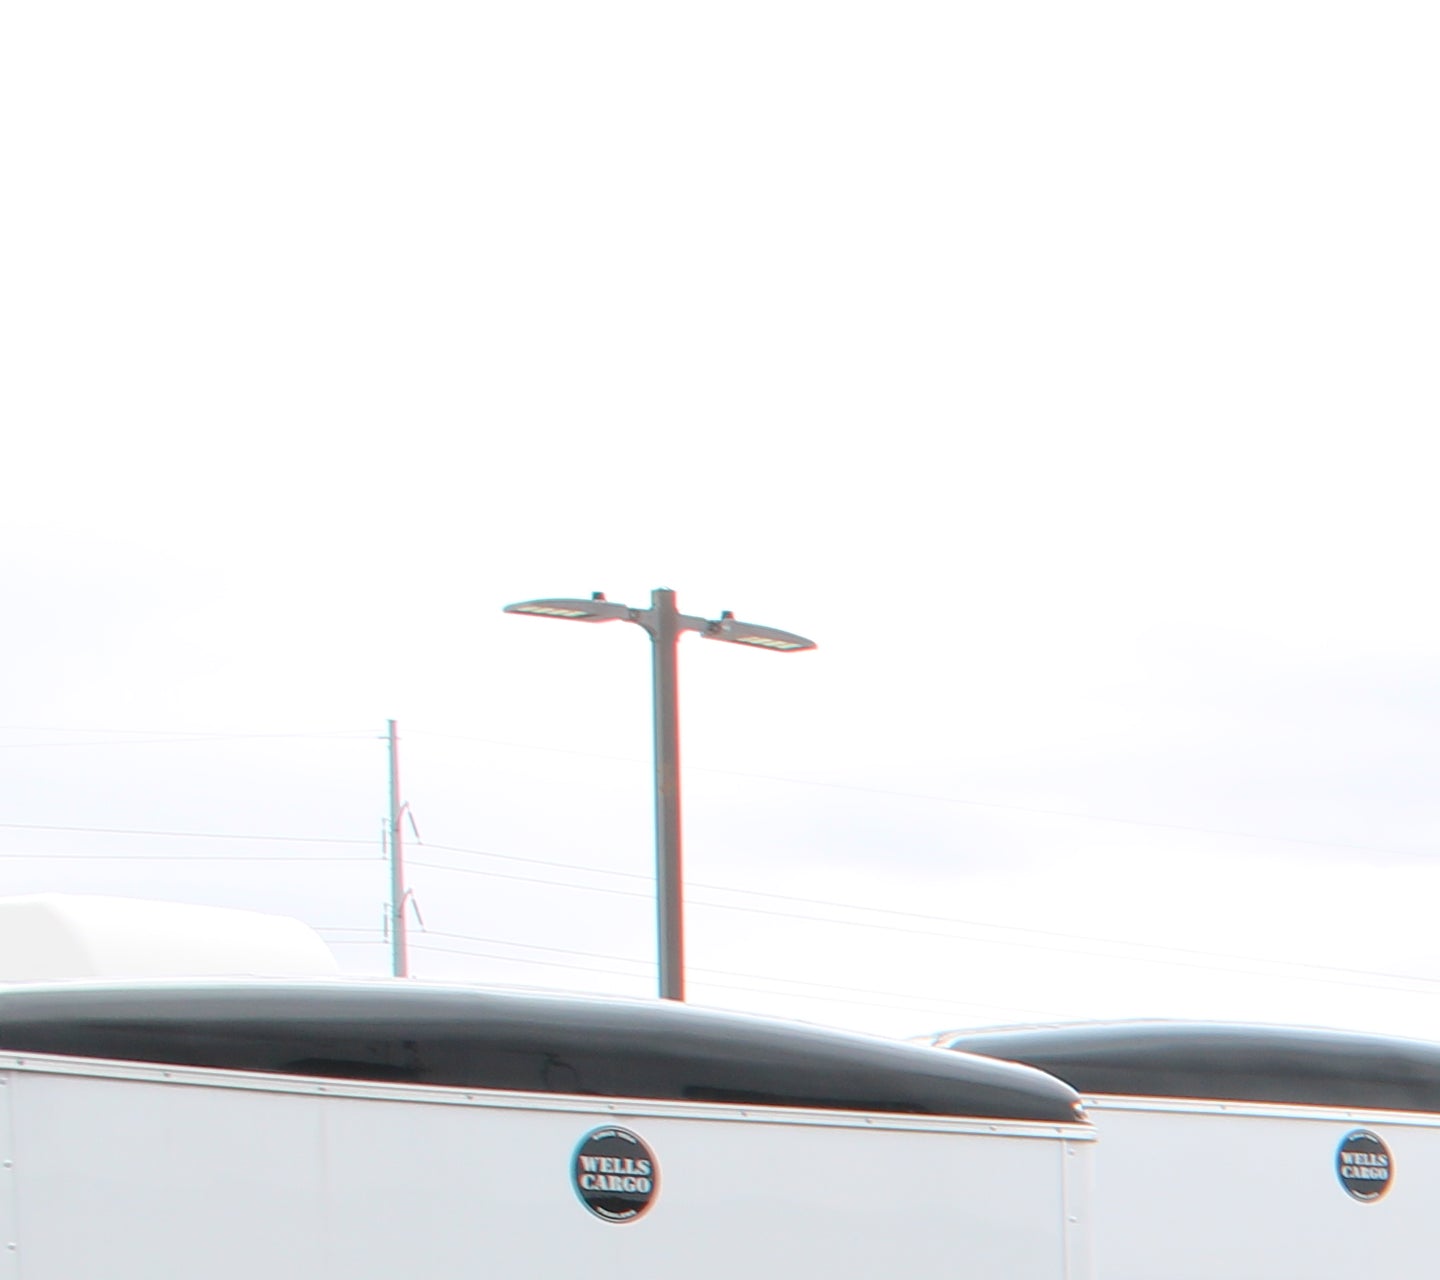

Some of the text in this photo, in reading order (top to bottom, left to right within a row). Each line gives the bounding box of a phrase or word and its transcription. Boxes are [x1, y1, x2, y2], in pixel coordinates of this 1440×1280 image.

[579, 1155, 652, 1176] WELLS
[1340, 1151, 1389, 1167] WELLS
[1341, 1165, 1389, 1181] CARGO
[580, 1174, 653, 1194] CARGO
